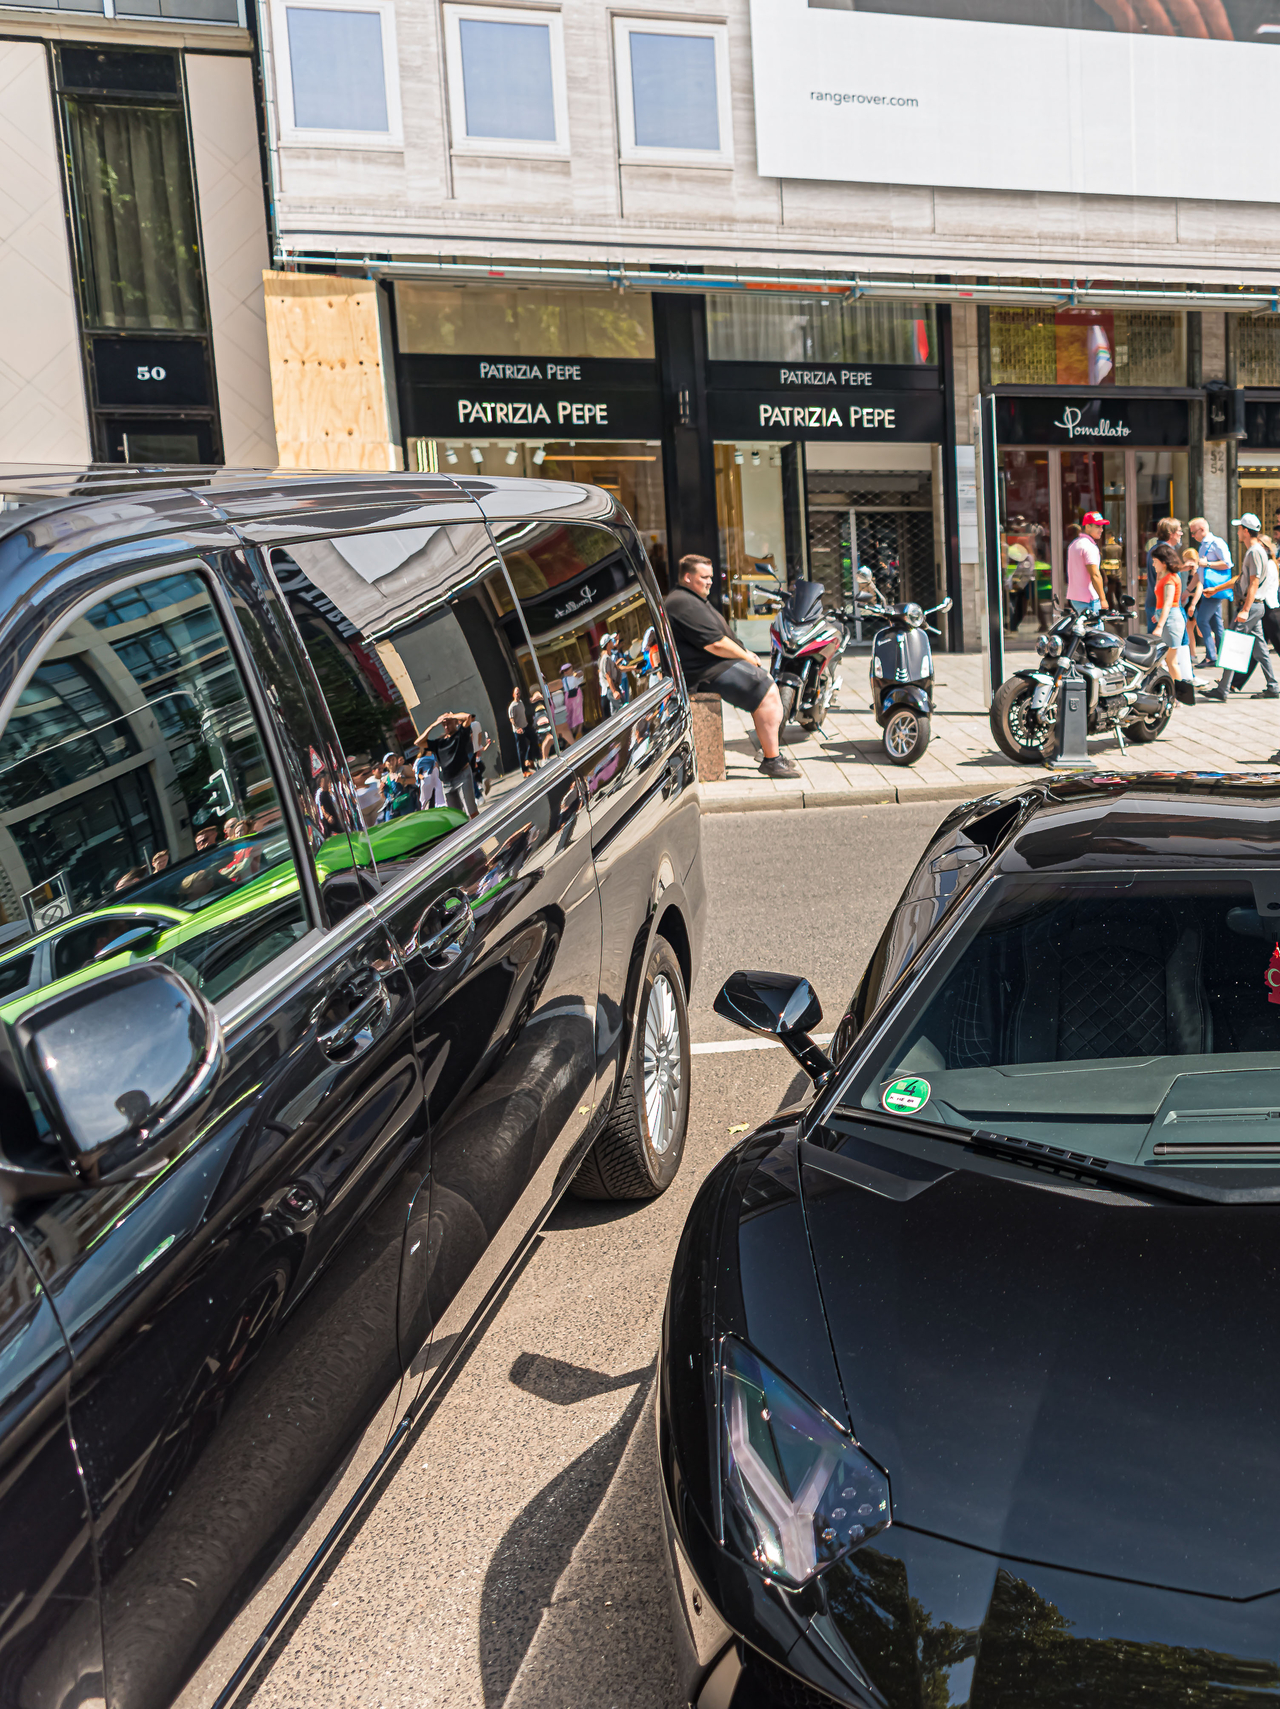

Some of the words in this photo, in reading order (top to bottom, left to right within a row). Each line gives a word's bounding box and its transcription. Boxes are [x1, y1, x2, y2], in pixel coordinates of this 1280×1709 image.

[810, 91, 919, 108] rangerover.com
[136, 366, 166, 381] 50
[480, 363, 543, 380] PATRIZIA
[547, 364, 582, 381] PEPE
[780, 369, 838, 385] PATRIZIA
[841, 370, 873, 386] PEPE
[457, 400, 552, 424] PATRIZIA
[557, 402, 609, 426] PEPE
[759, 405, 844, 428] PATRIZIA
[849, 407, 896, 429] PEPE
[1054, 406, 1132, 438] Pomellato
[1210, 451, 1224, 462] 52
[1210, 463, 1225, 474] 54
[903, 1080, 919, 1096] 4
